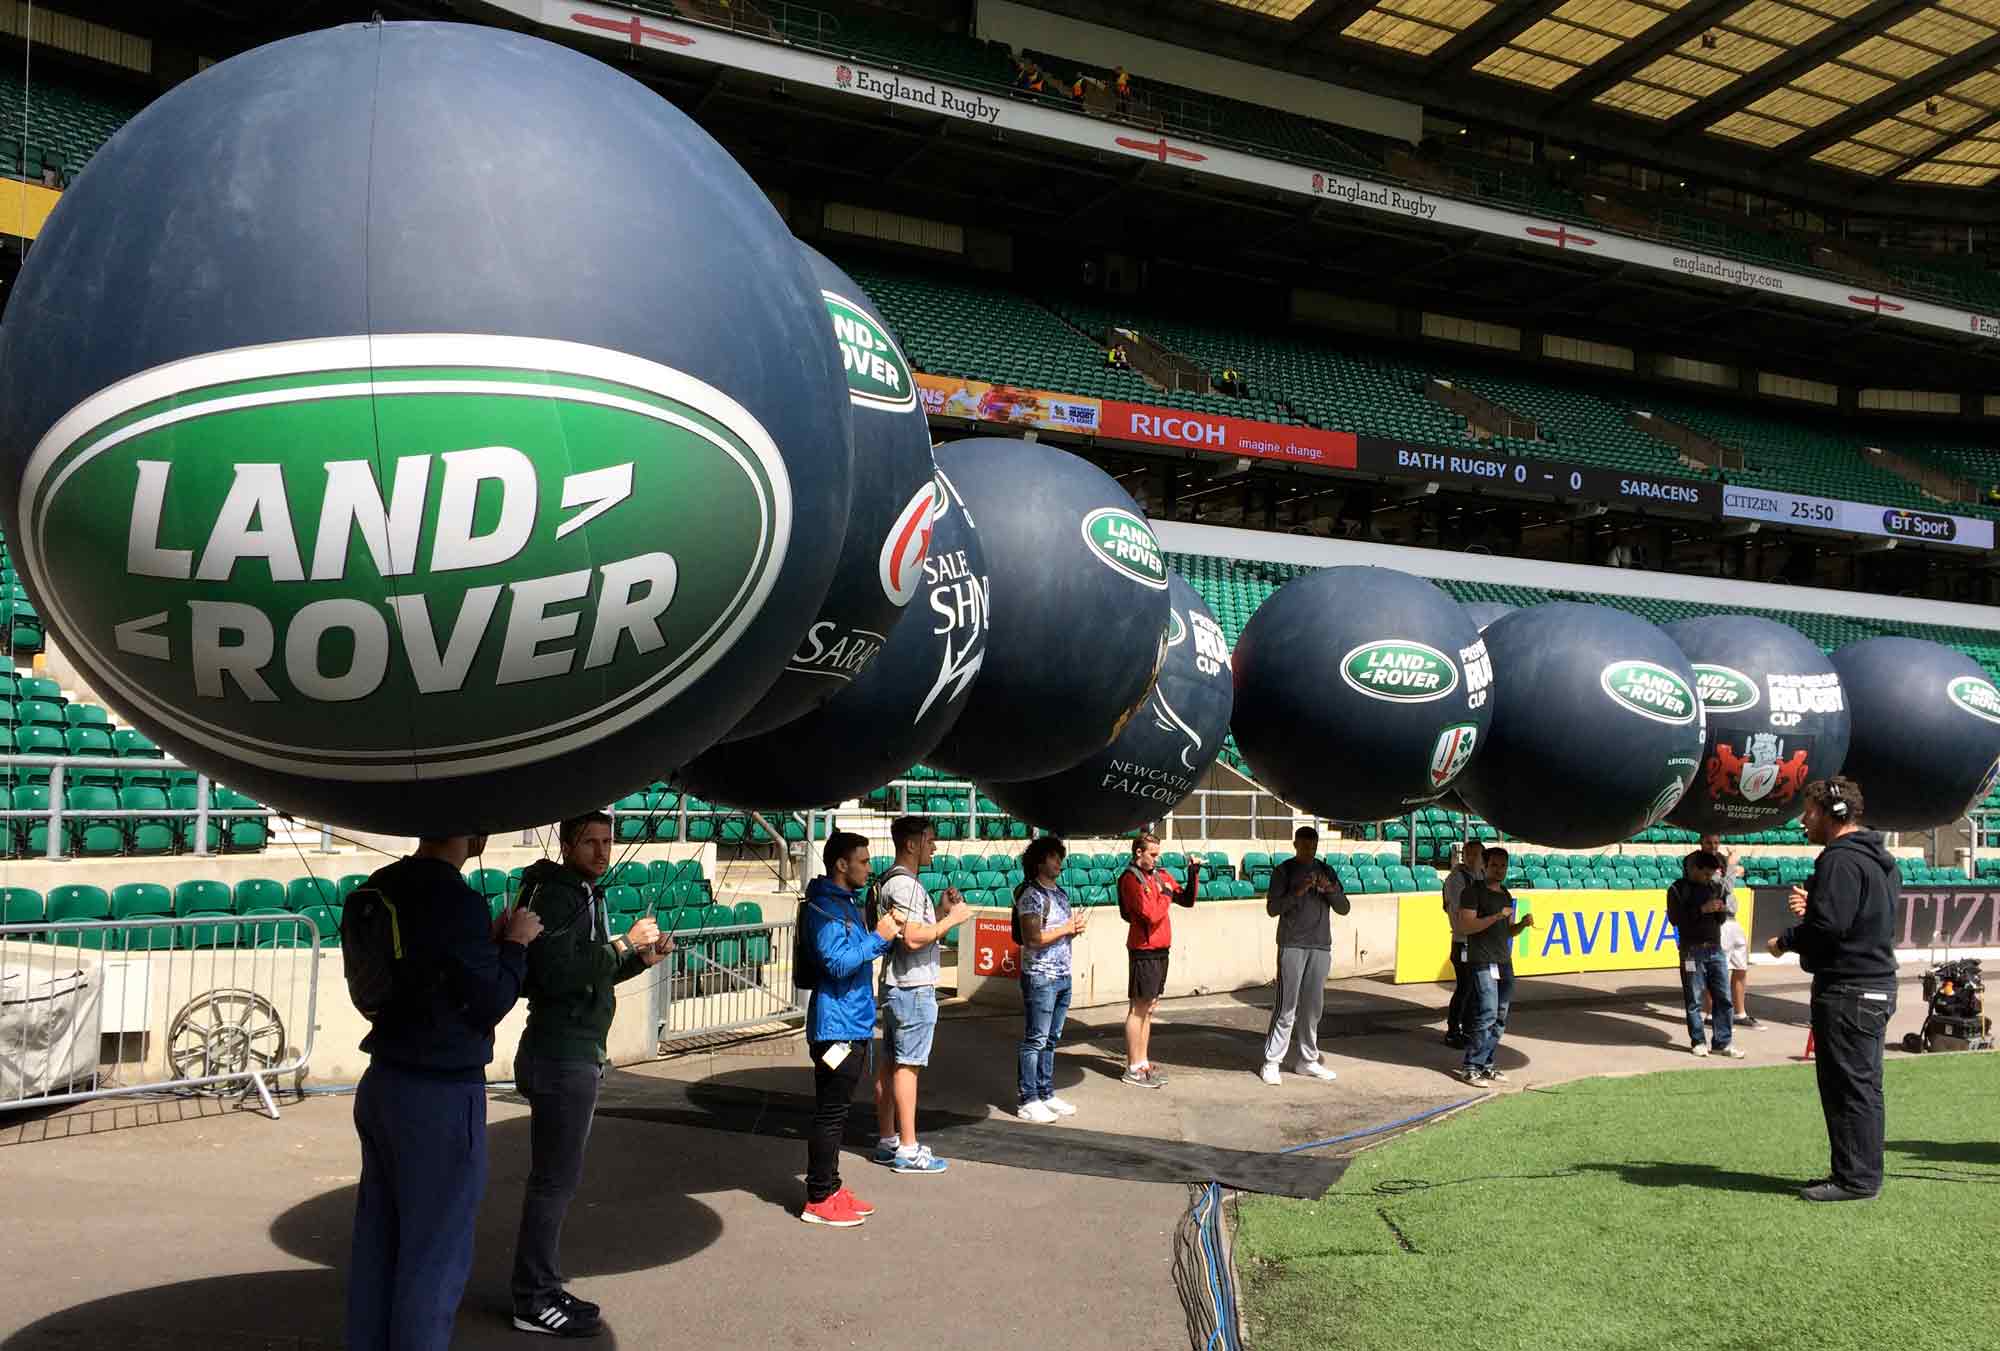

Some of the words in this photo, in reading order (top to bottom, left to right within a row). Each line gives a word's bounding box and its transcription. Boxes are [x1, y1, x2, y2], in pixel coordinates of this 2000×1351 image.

[856, 70, 937, 106] England
[941, 90, 1000, 123] Rugby
[1327, 177, 1388, 206] England
[1391, 191, 1437, 218] Rugby
[1672, 254, 1783, 290] englandrugby.com
[1130, 411, 1226, 447] RICOH
[1397, 450, 1445, 471] BATH
[1450, 456, 1507, 479] RUGBY
[1514, 464, 1527, 483] 0
[1570, 471, 1582, 490] 0
[1619, 479, 1699, 503] SARACENS
[126, 445, 538, 583] LAND
[1724, 493, 1778, 513] CITIZEN
[1790, 501, 1834, 522] 25:50
[1108, 518, 1151, 547] LAND
[1891, 513, 1912, 531] BT
[1914, 517, 1949, 536] Sport
[922, 550, 970, 585] SALE
[1115, 538, 1163, 577] ROVER
[187, 550, 678, 703] ROVER
[1196, 655, 1220, 677] CUP
[1367, 651, 1426, 671] LAND
[1371, 668, 1440, 689] ROVER
[1627, 669, 1676, 693] LAND
[1468, 690, 1487, 709] CUP
[1629, 684, 1686, 715] ROVER
[1769, 711, 1802, 727] CUP
[979, 947, 994, 970] 3
